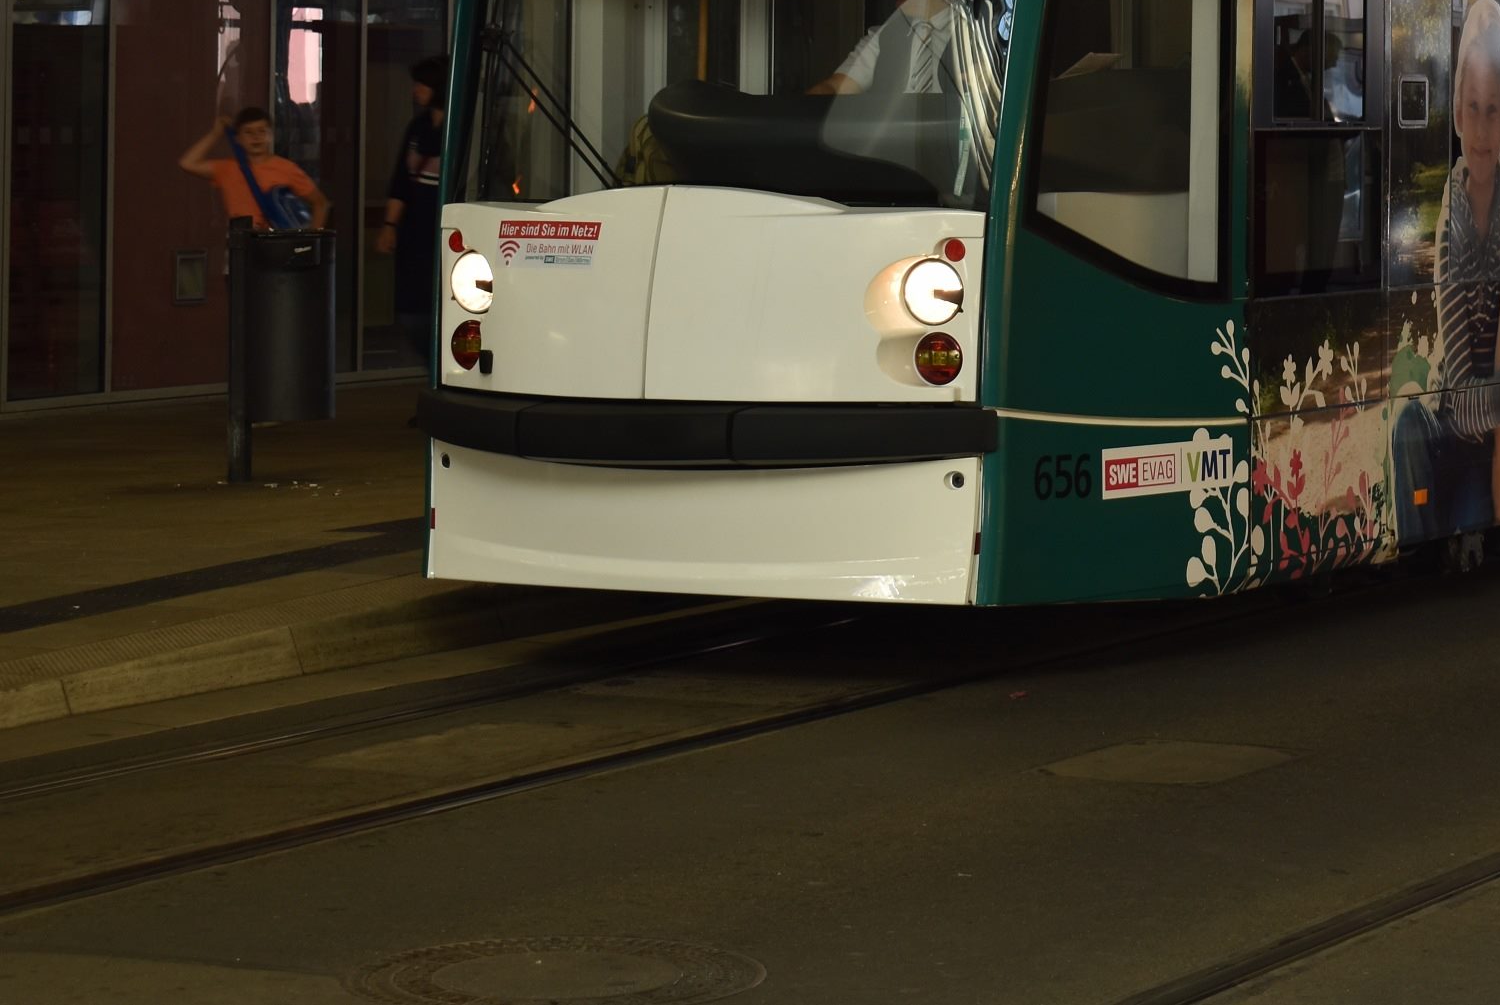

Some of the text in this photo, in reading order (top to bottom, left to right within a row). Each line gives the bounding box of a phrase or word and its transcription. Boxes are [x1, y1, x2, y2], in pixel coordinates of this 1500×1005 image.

[500, 223, 598, 238] Hier sind Sie im Netz!
[526, 243, 594, 255] Die Bahn mit WLAN
[1034, 453, 1092, 500] 656
[1108, 459, 1173, 486] SWE EVAG
[1186, 448, 1231, 483] VMT
